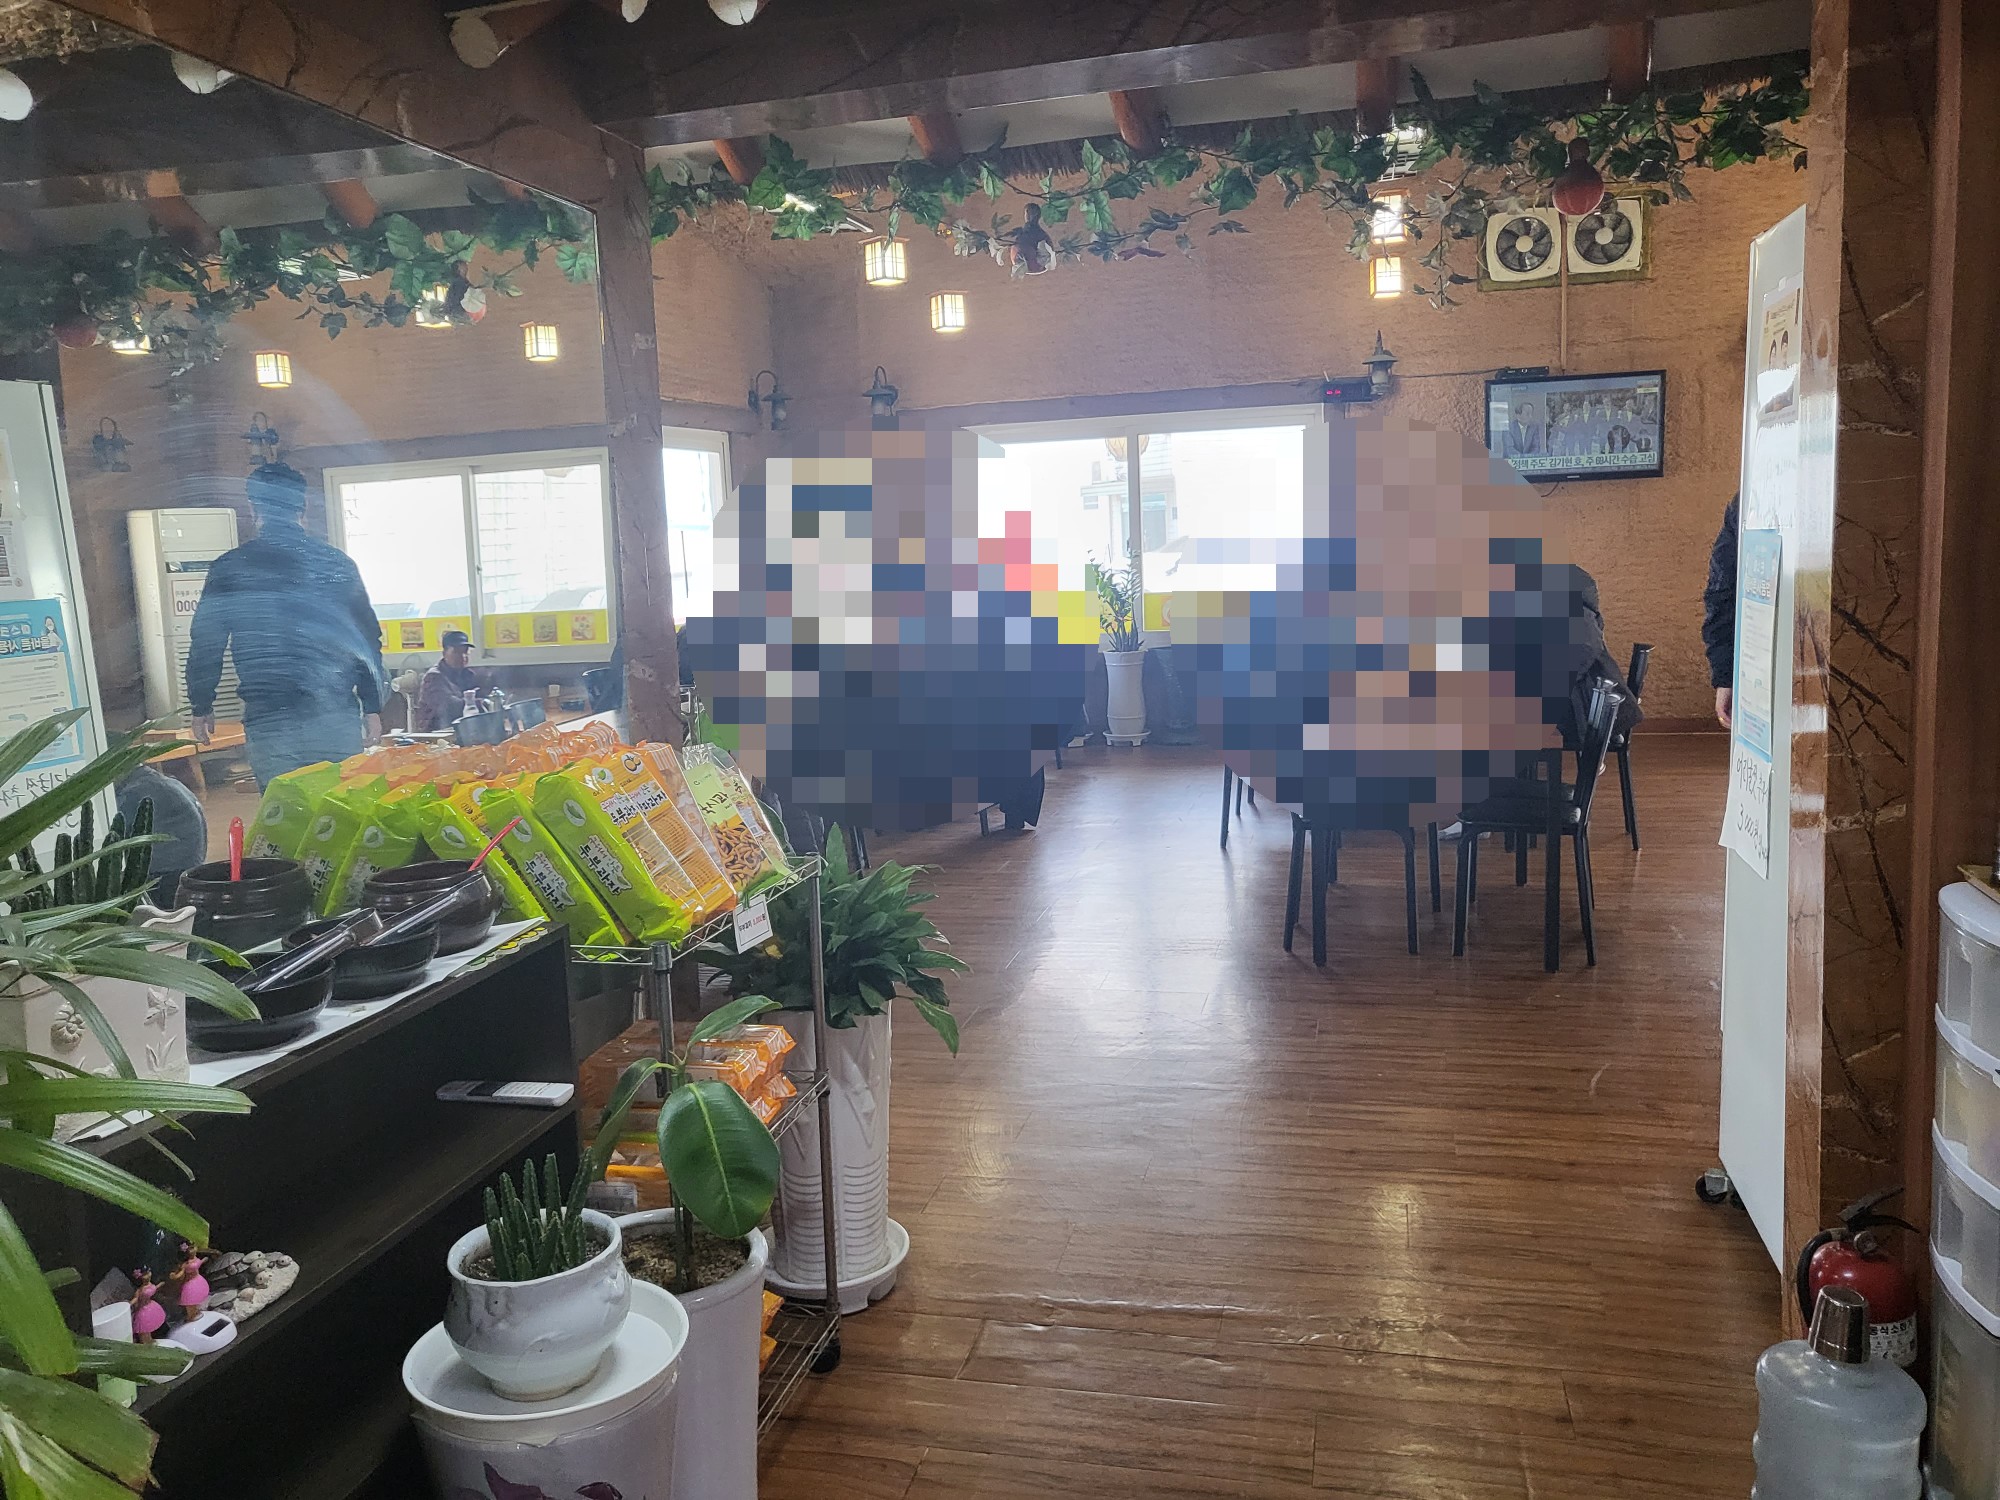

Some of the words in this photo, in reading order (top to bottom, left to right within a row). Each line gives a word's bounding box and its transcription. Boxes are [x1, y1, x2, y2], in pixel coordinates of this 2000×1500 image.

[1549, 457, 1573, 468] 김기현
[1586, 456, 1594, 466] 주
[1638, 452, 1656, 464] 고심
[525, 860, 565, 910] 두부과자
[579, 844, 621, 894] 두부과자
